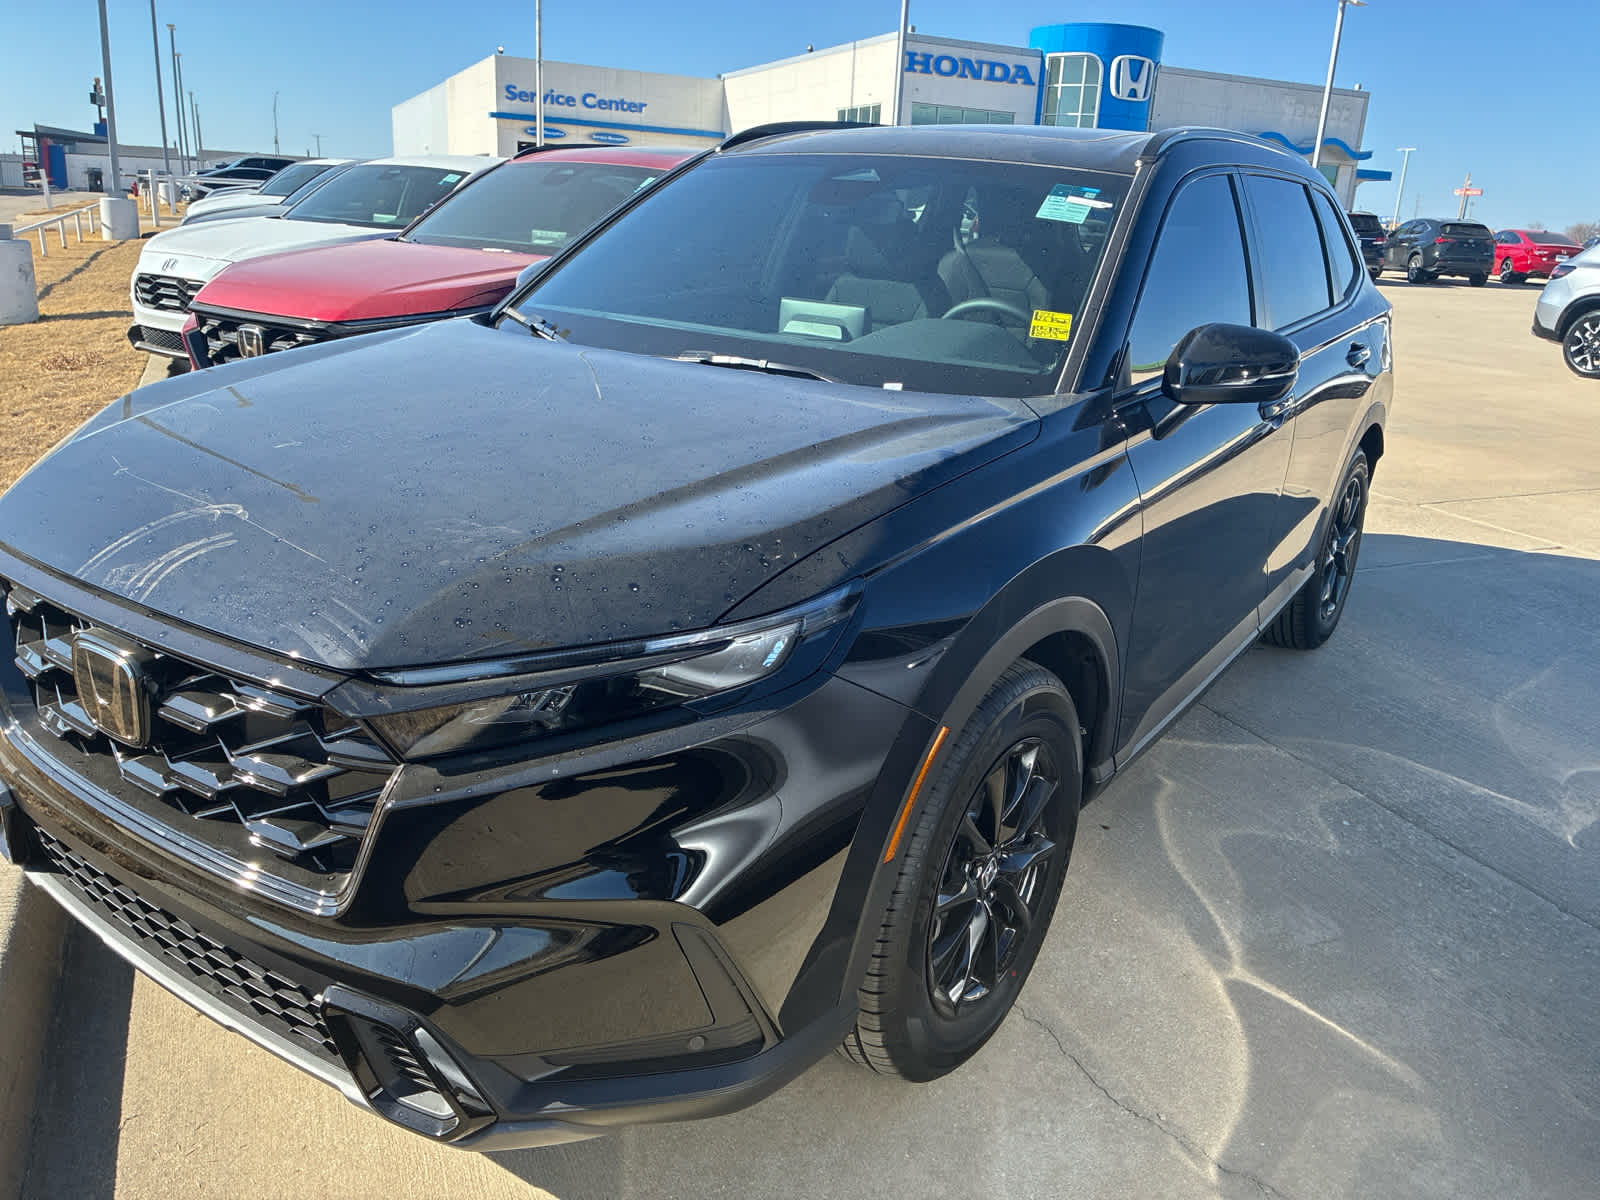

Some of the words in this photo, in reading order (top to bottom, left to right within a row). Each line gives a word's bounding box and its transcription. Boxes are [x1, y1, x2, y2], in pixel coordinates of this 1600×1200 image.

[904, 51, 1036, 86] HONDA
[504, 84, 577, 107] Service
[582, 93, 648, 113] Center
